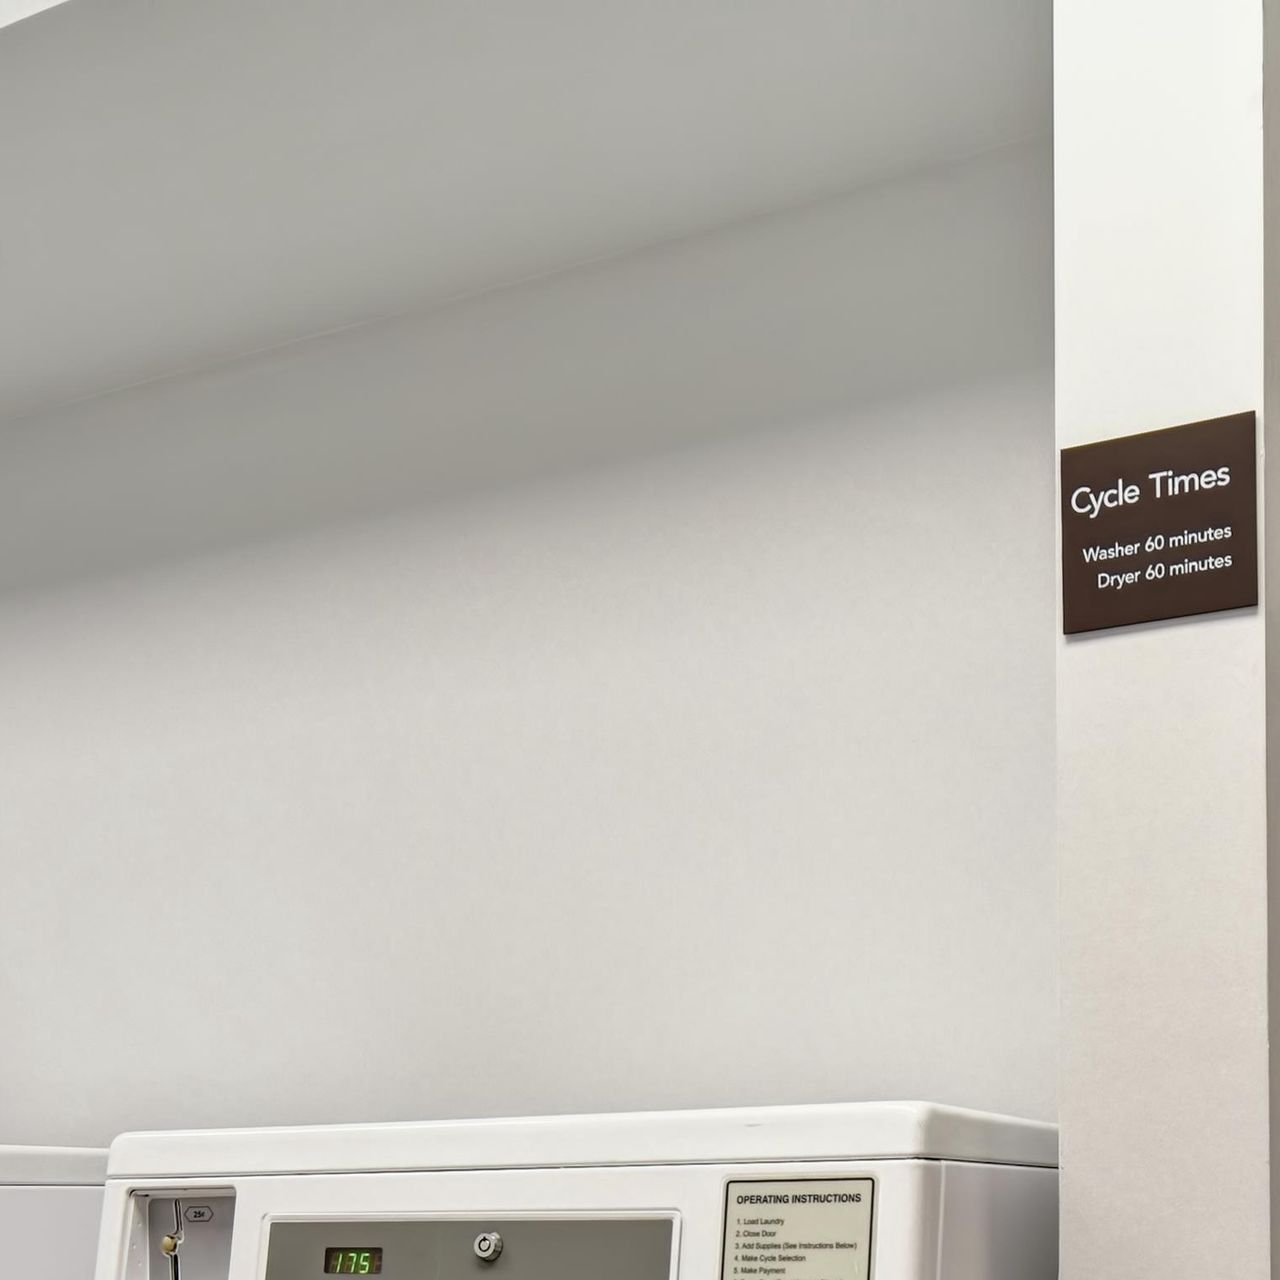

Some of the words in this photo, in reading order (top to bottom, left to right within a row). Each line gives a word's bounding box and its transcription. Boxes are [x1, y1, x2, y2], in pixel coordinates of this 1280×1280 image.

[1071, 478, 1139, 518] Cycle
[1148, 467, 1229, 497] Times
[1082, 542, 1140, 562] Washer
[1145, 534, 1164, 551] 60
[1169, 526, 1231, 547] minutes
[1098, 571, 1140, 589] Dryer
[1145, 563, 1164, 579] 60
[1169, 555, 1231, 576] minutes
[736, 1194, 789, 1204] OPERATING
[791, 1193, 861, 1203] INSTRUCTIONS
[336, 1252, 370, 1274] 175
